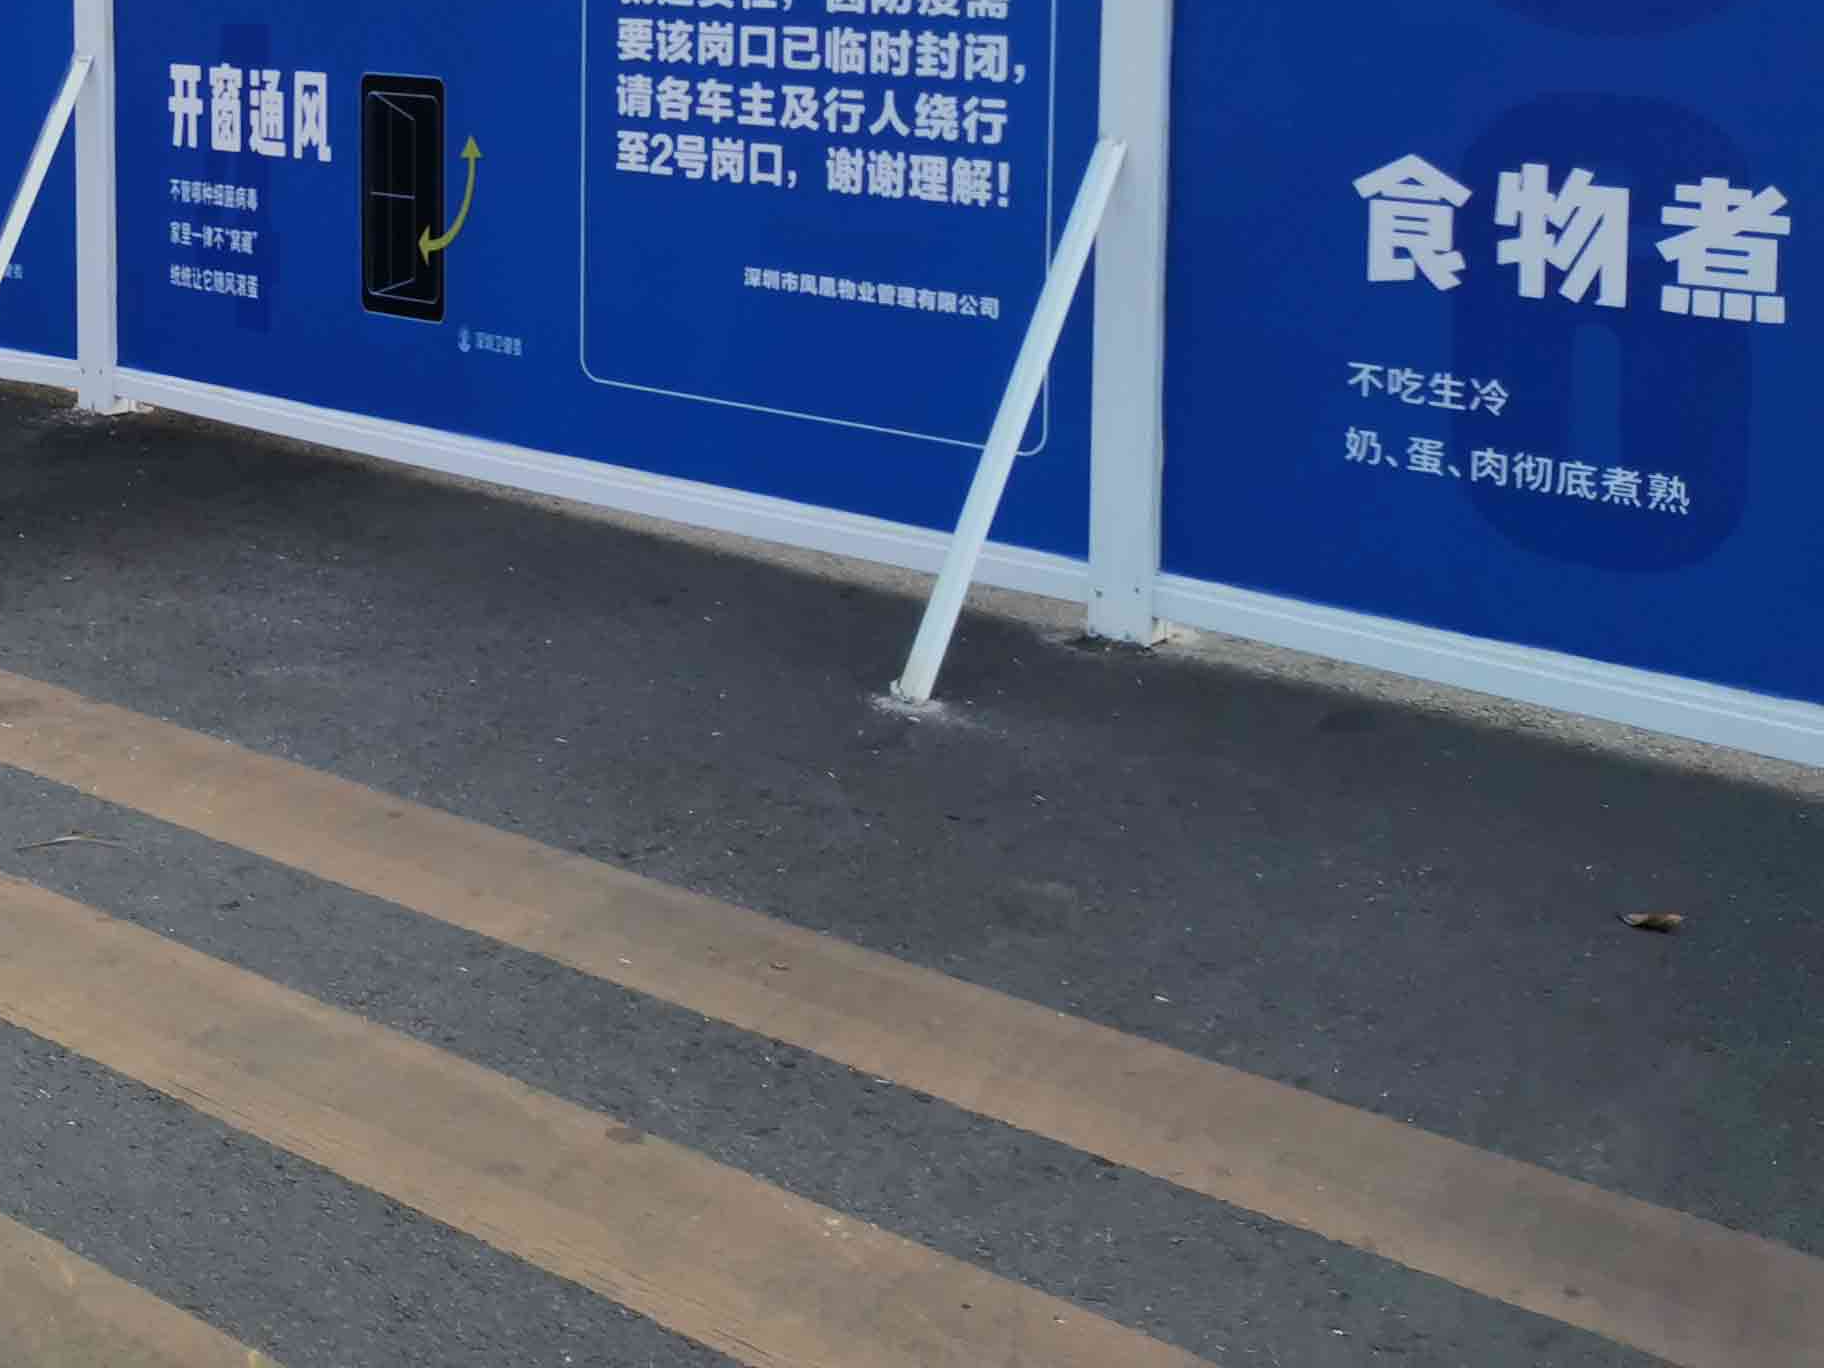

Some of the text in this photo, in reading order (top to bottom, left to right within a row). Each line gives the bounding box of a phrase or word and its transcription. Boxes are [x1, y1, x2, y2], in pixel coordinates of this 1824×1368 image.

[168, 63, 332, 163] 开窗通风
[615, 73, 1009, 145] 请各车主及行人绕行
[1352, 153, 1791, 324] 食物煮
[1347, 362, 1510, 416] 不吃生冷
[1344, 427, 1691, 515] 奶、蛋、肉彻底煮熟
